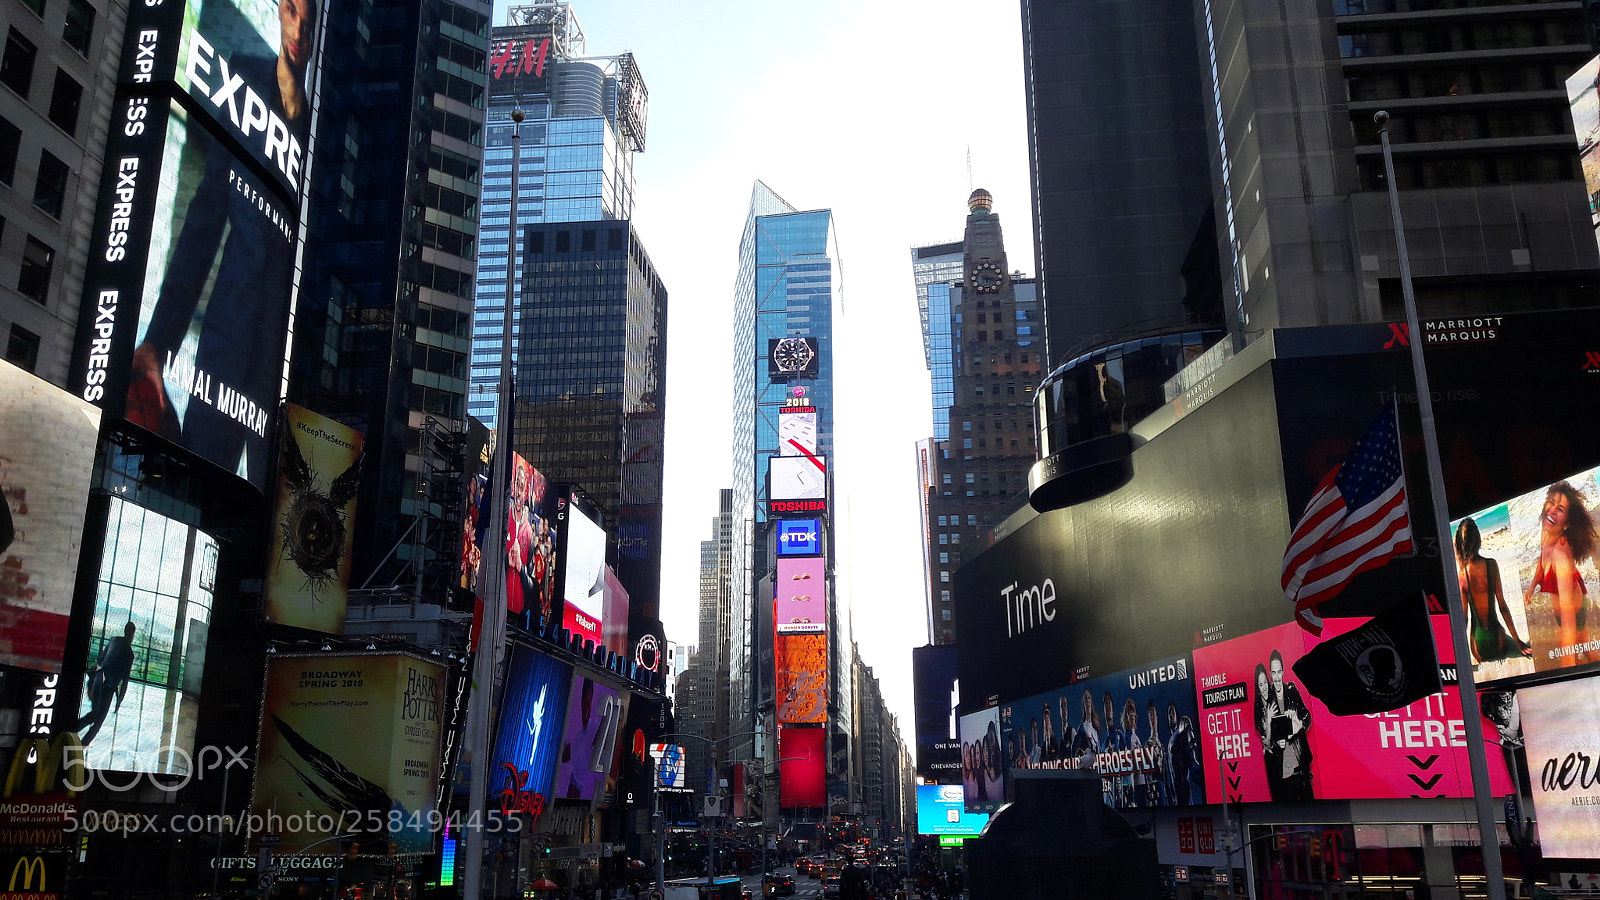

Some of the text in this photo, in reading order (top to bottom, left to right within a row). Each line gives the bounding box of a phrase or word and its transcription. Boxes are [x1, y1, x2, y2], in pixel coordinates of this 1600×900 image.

[490, 38, 551, 80] H&M
[105, 157, 140, 263] EXPRESS
[228, 169, 293, 246] PERFORMANC
[1425, 317, 1504, 331] MARRIOTT
[83, 290, 119, 402] EXPRESS
[1427, 330, 1496, 343] MARQUIS
[162, 350, 268, 439] JAMAL MURRAY
[1186, 373, 1216, 401] MARRIOTT
[1187, 387, 1214, 411] MARQUIS
[786, 398, 810, 407] 2018
[770, 501, 826, 513] TOSHIBA
[788, 532, 817, 542] TDK
[1000, 578, 1057, 639] Time
[298, 680, 364, 689] SPRING 2018
[301, 670, 363, 679] BROADWAY
[407, 667, 440, 701] HARRY
[1128, 664, 1176, 690] UNITED
[1201, 672, 1228, 689] T-MOBILE
[1205, 686, 1245, 705] TOURIST PLAN
[401, 691, 440, 725] POTTER
[1207, 709, 1242, 735] GET IT
[1379, 719, 1468, 749] HERE
[1133, 747, 1155, 771] FLY
[1215, 733, 1252, 761] HERE
[0, 803, 75, 814] McDonald's
[10, 815, 61, 823] Restaurant
[209, 857, 257, 870] GIFTS
